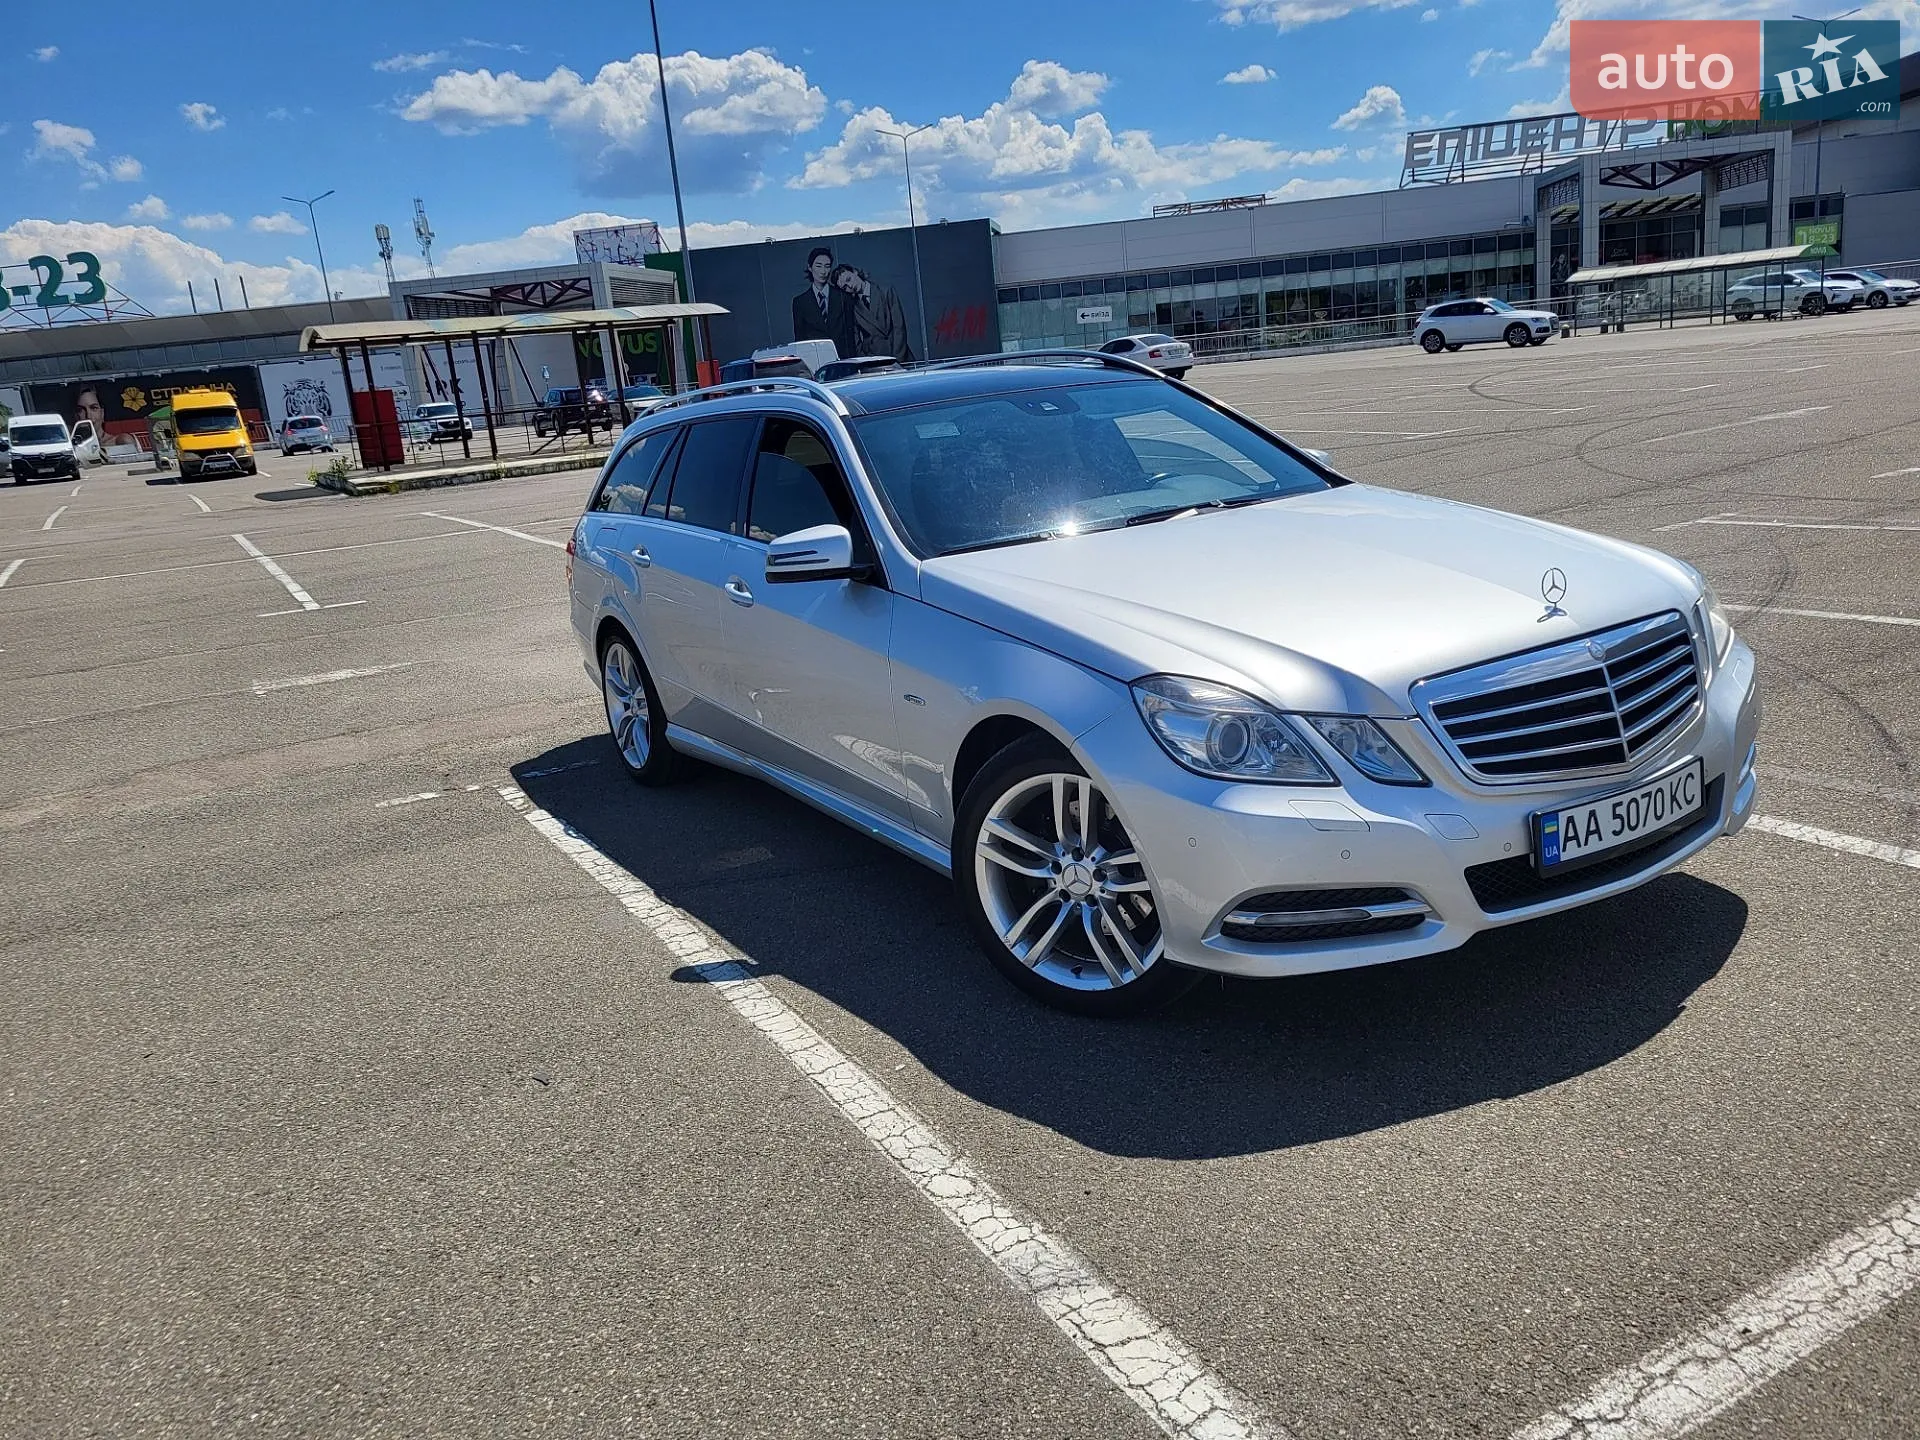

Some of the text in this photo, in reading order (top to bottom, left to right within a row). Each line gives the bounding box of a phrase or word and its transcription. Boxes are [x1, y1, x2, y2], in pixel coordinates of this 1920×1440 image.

[0, 251, 106, 312] -23
[1561, 772, 1696, 853] AA 5070 KC
[1545, 847, 1559, 858] UA
